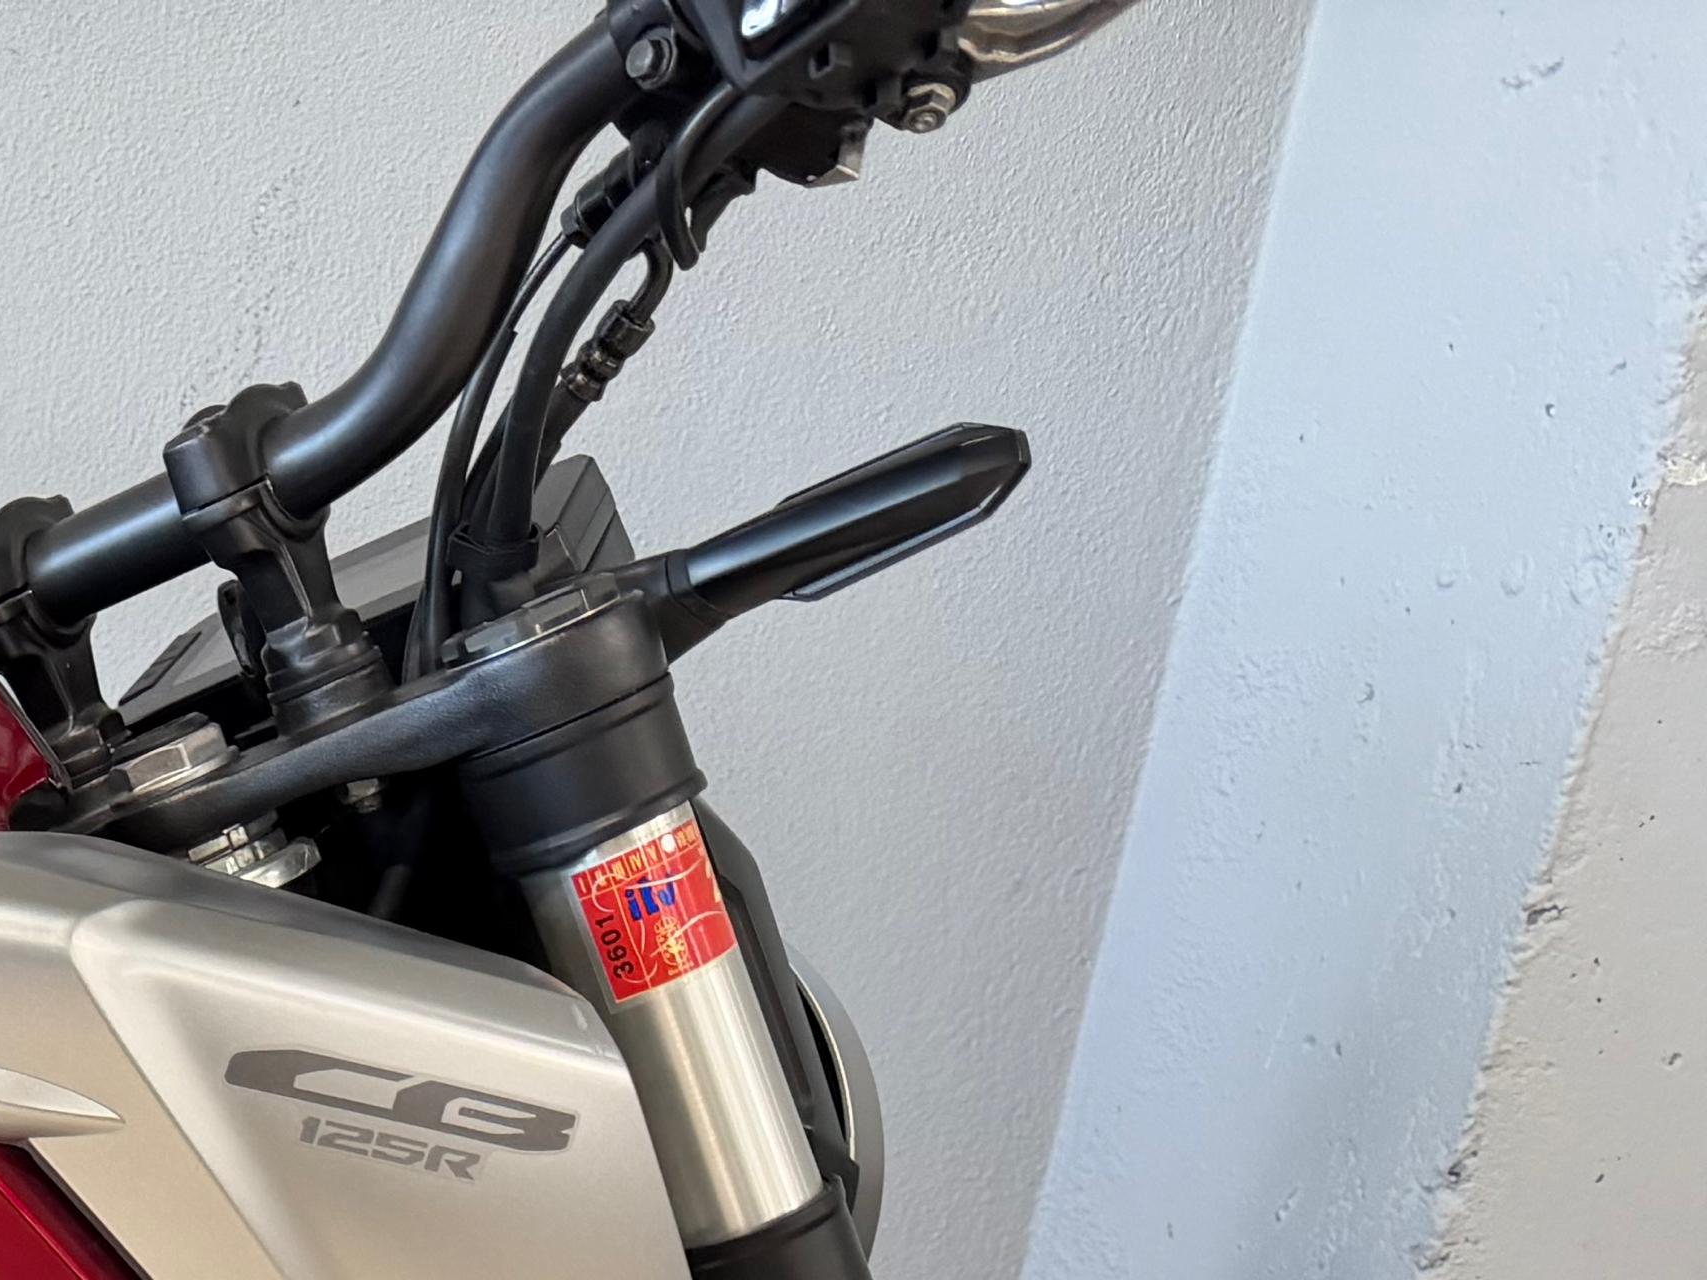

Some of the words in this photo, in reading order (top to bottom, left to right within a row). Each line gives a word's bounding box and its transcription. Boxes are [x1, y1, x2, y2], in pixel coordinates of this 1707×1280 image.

[594, 913, 635, 979] 3601
[224, 1049, 578, 1152] CB
[298, 1115, 481, 1180] 125R
